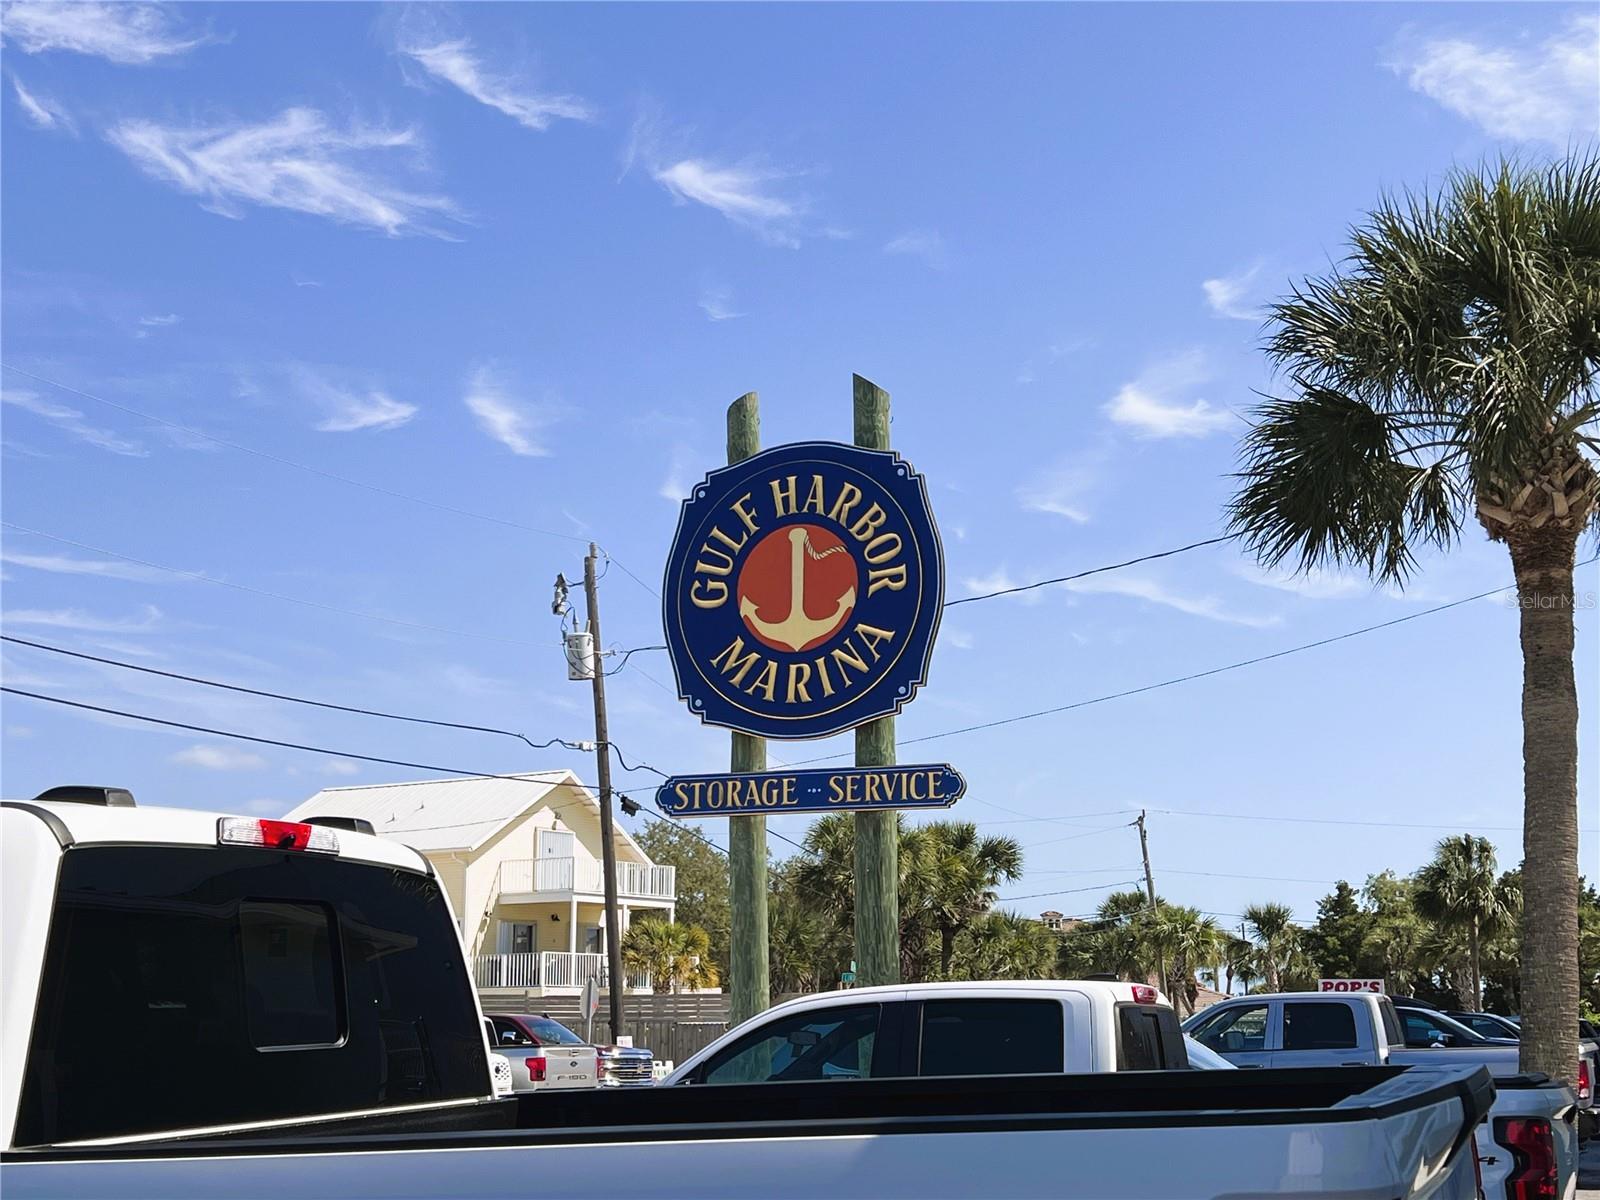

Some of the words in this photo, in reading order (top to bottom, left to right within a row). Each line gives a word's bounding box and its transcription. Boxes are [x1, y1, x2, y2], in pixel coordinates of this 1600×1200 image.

[690, 492, 761, 609] GULF
[768, 474, 908, 599] HARBOR
[709, 622, 897, 704] MARINA
[673, 777, 799, 811] STORAGE
[828, 771, 946, 803] SERVICE
[1321, 981, 1381, 993] POP'S
